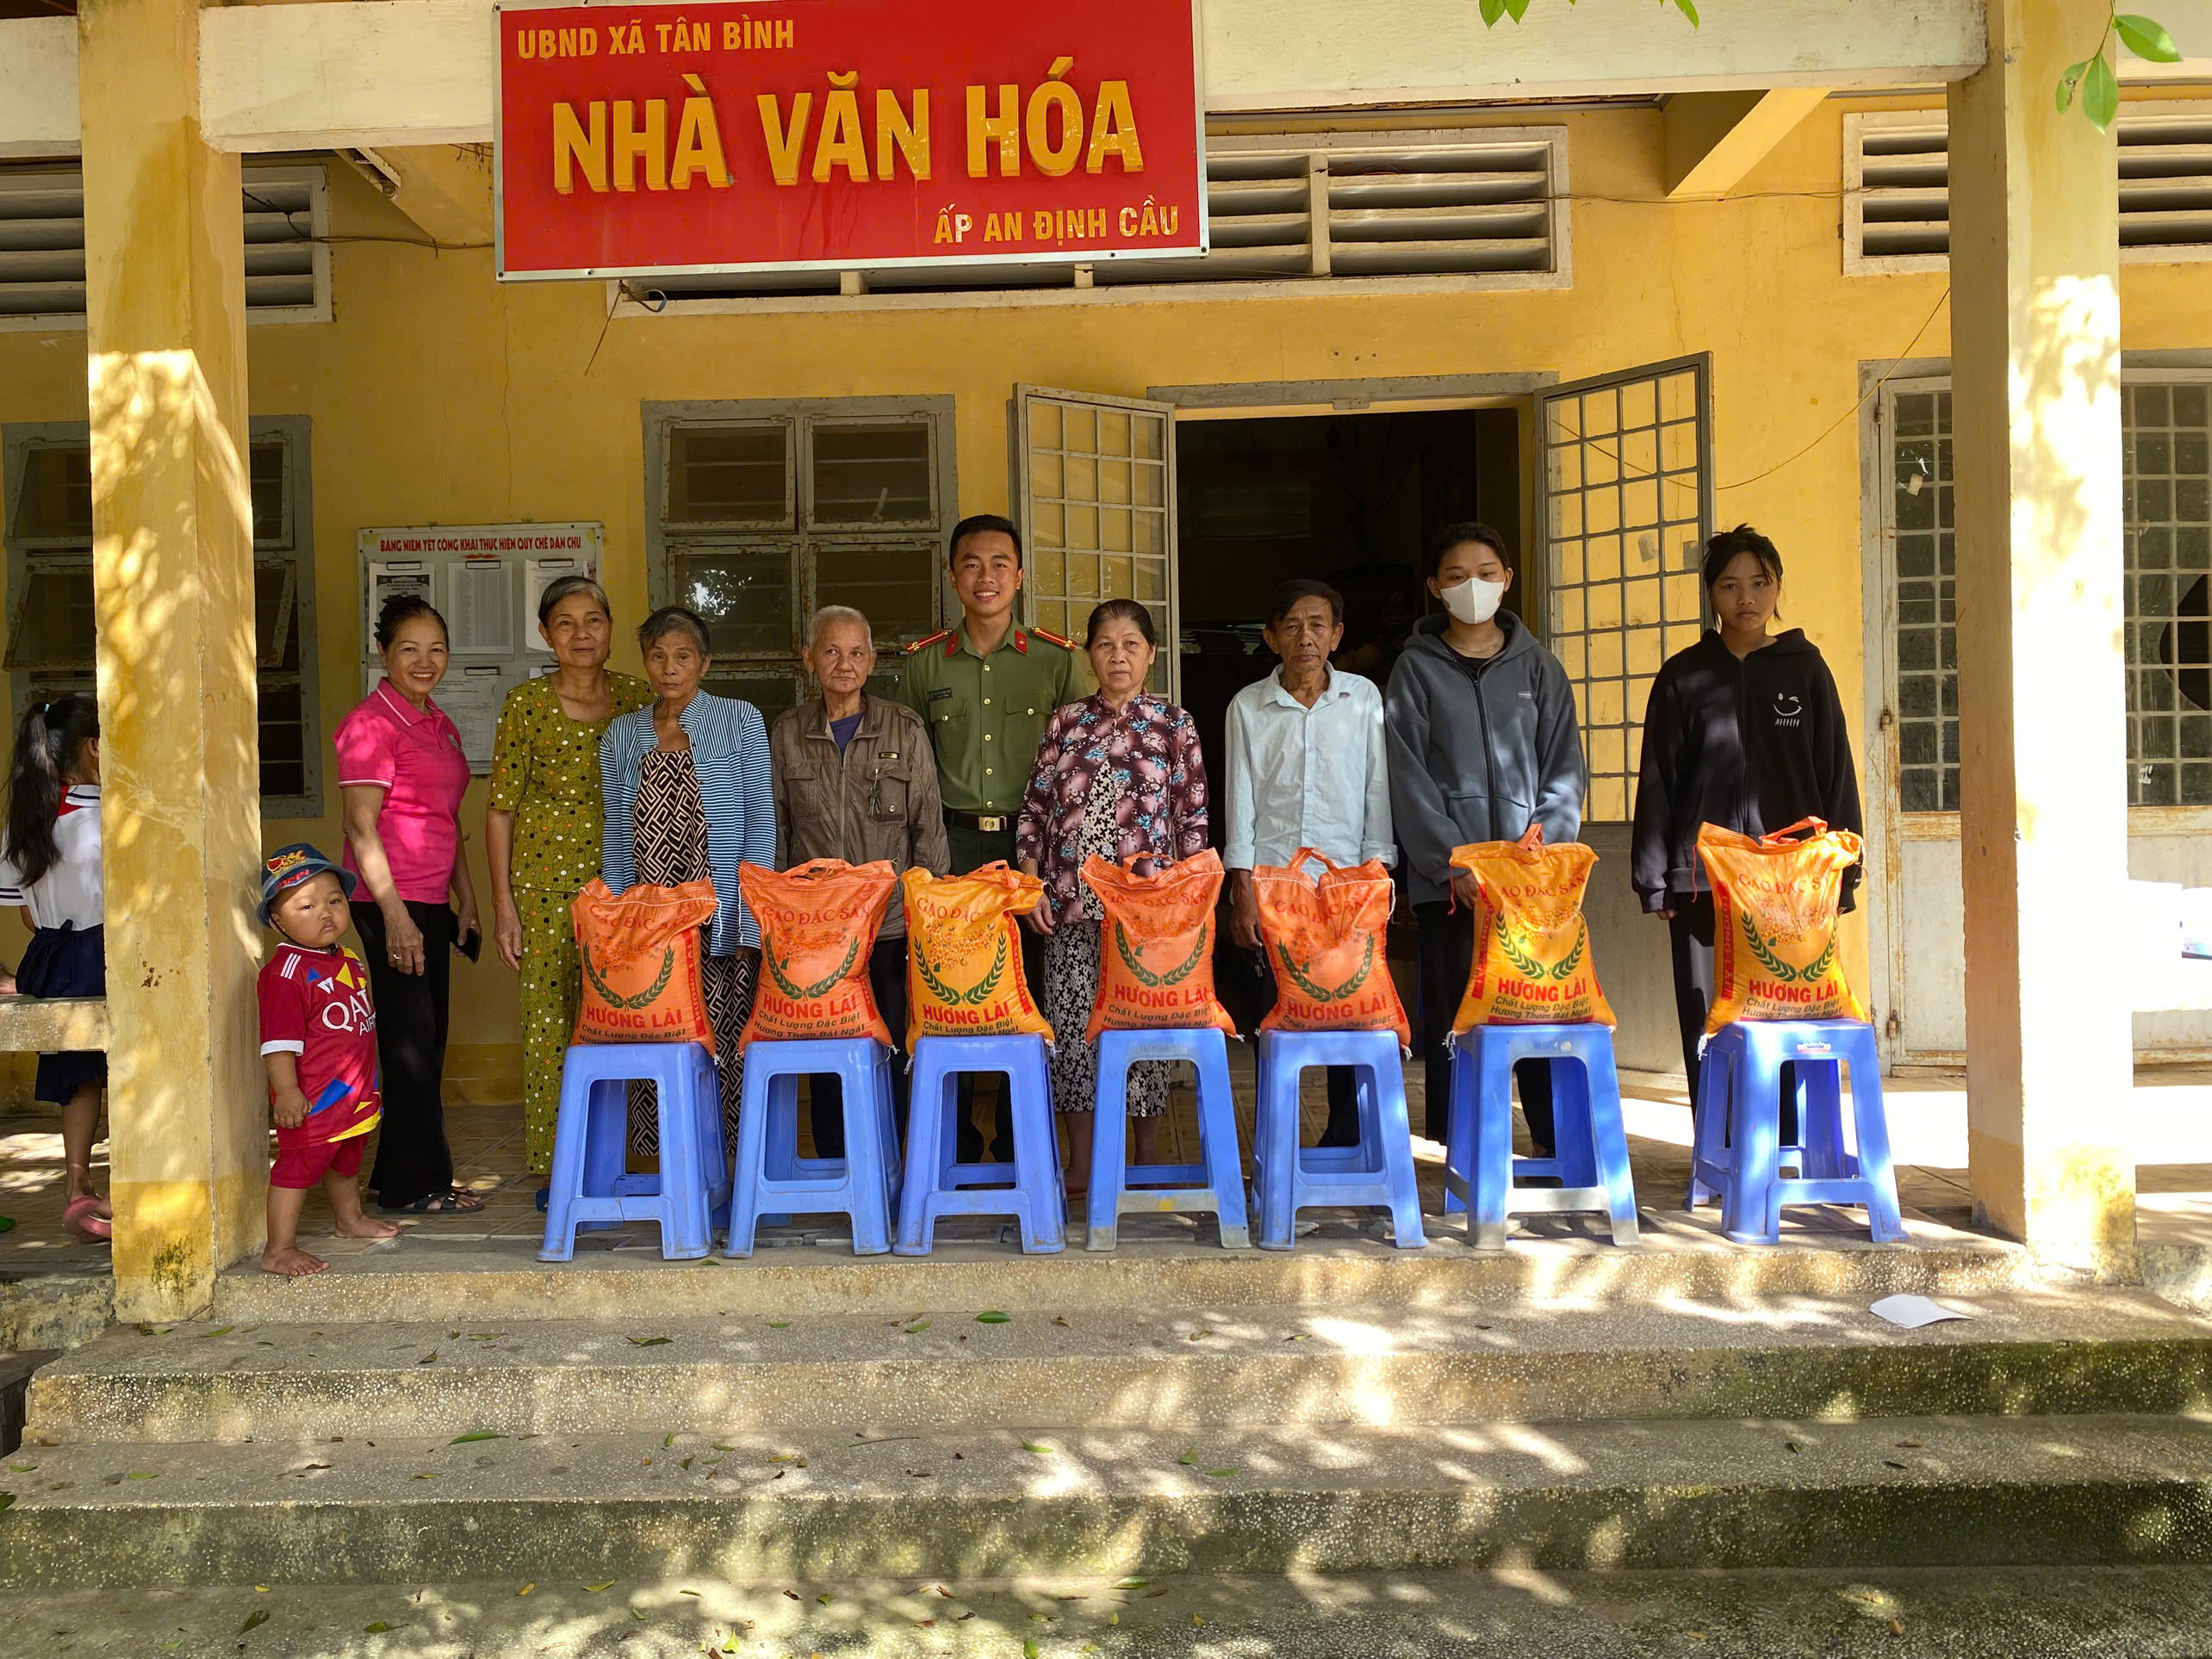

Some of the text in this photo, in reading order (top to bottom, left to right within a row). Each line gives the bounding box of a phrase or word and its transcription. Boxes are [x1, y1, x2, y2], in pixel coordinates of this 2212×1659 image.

[518, 14, 794, 59] UBND XÃ TÂN BÌNH
[553, 56, 1144, 194] NHÀ VĂN HÓA
[934, 195, 1179, 246] ẤP AN ĐỊNH CẦU
[437, 537, 458, 551] CÔNG
[460, 537, 478, 551] KHAI
[517, 537, 533, 550] QUY
[1115, 984, 1178, 1008] HƯƠNG
[1498, 977, 1587, 1002] HƯƠNG LÀI
[1749, 979, 1839, 1003] HƯƠNG LÀI
[322, 988, 376, 1032] QAT
[587, 1005, 683, 1028] HƯƠNG LÀI
[759, 1010, 778, 1023] Chất
[763, 992, 856, 1018] HƯƠNG LÀI
[923, 1000, 1010, 1024] HƯƠNG LÀI
[1288, 992, 1387, 1021] HƯƠNG LÀI
[581, 1023, 603, 1035] Chất
